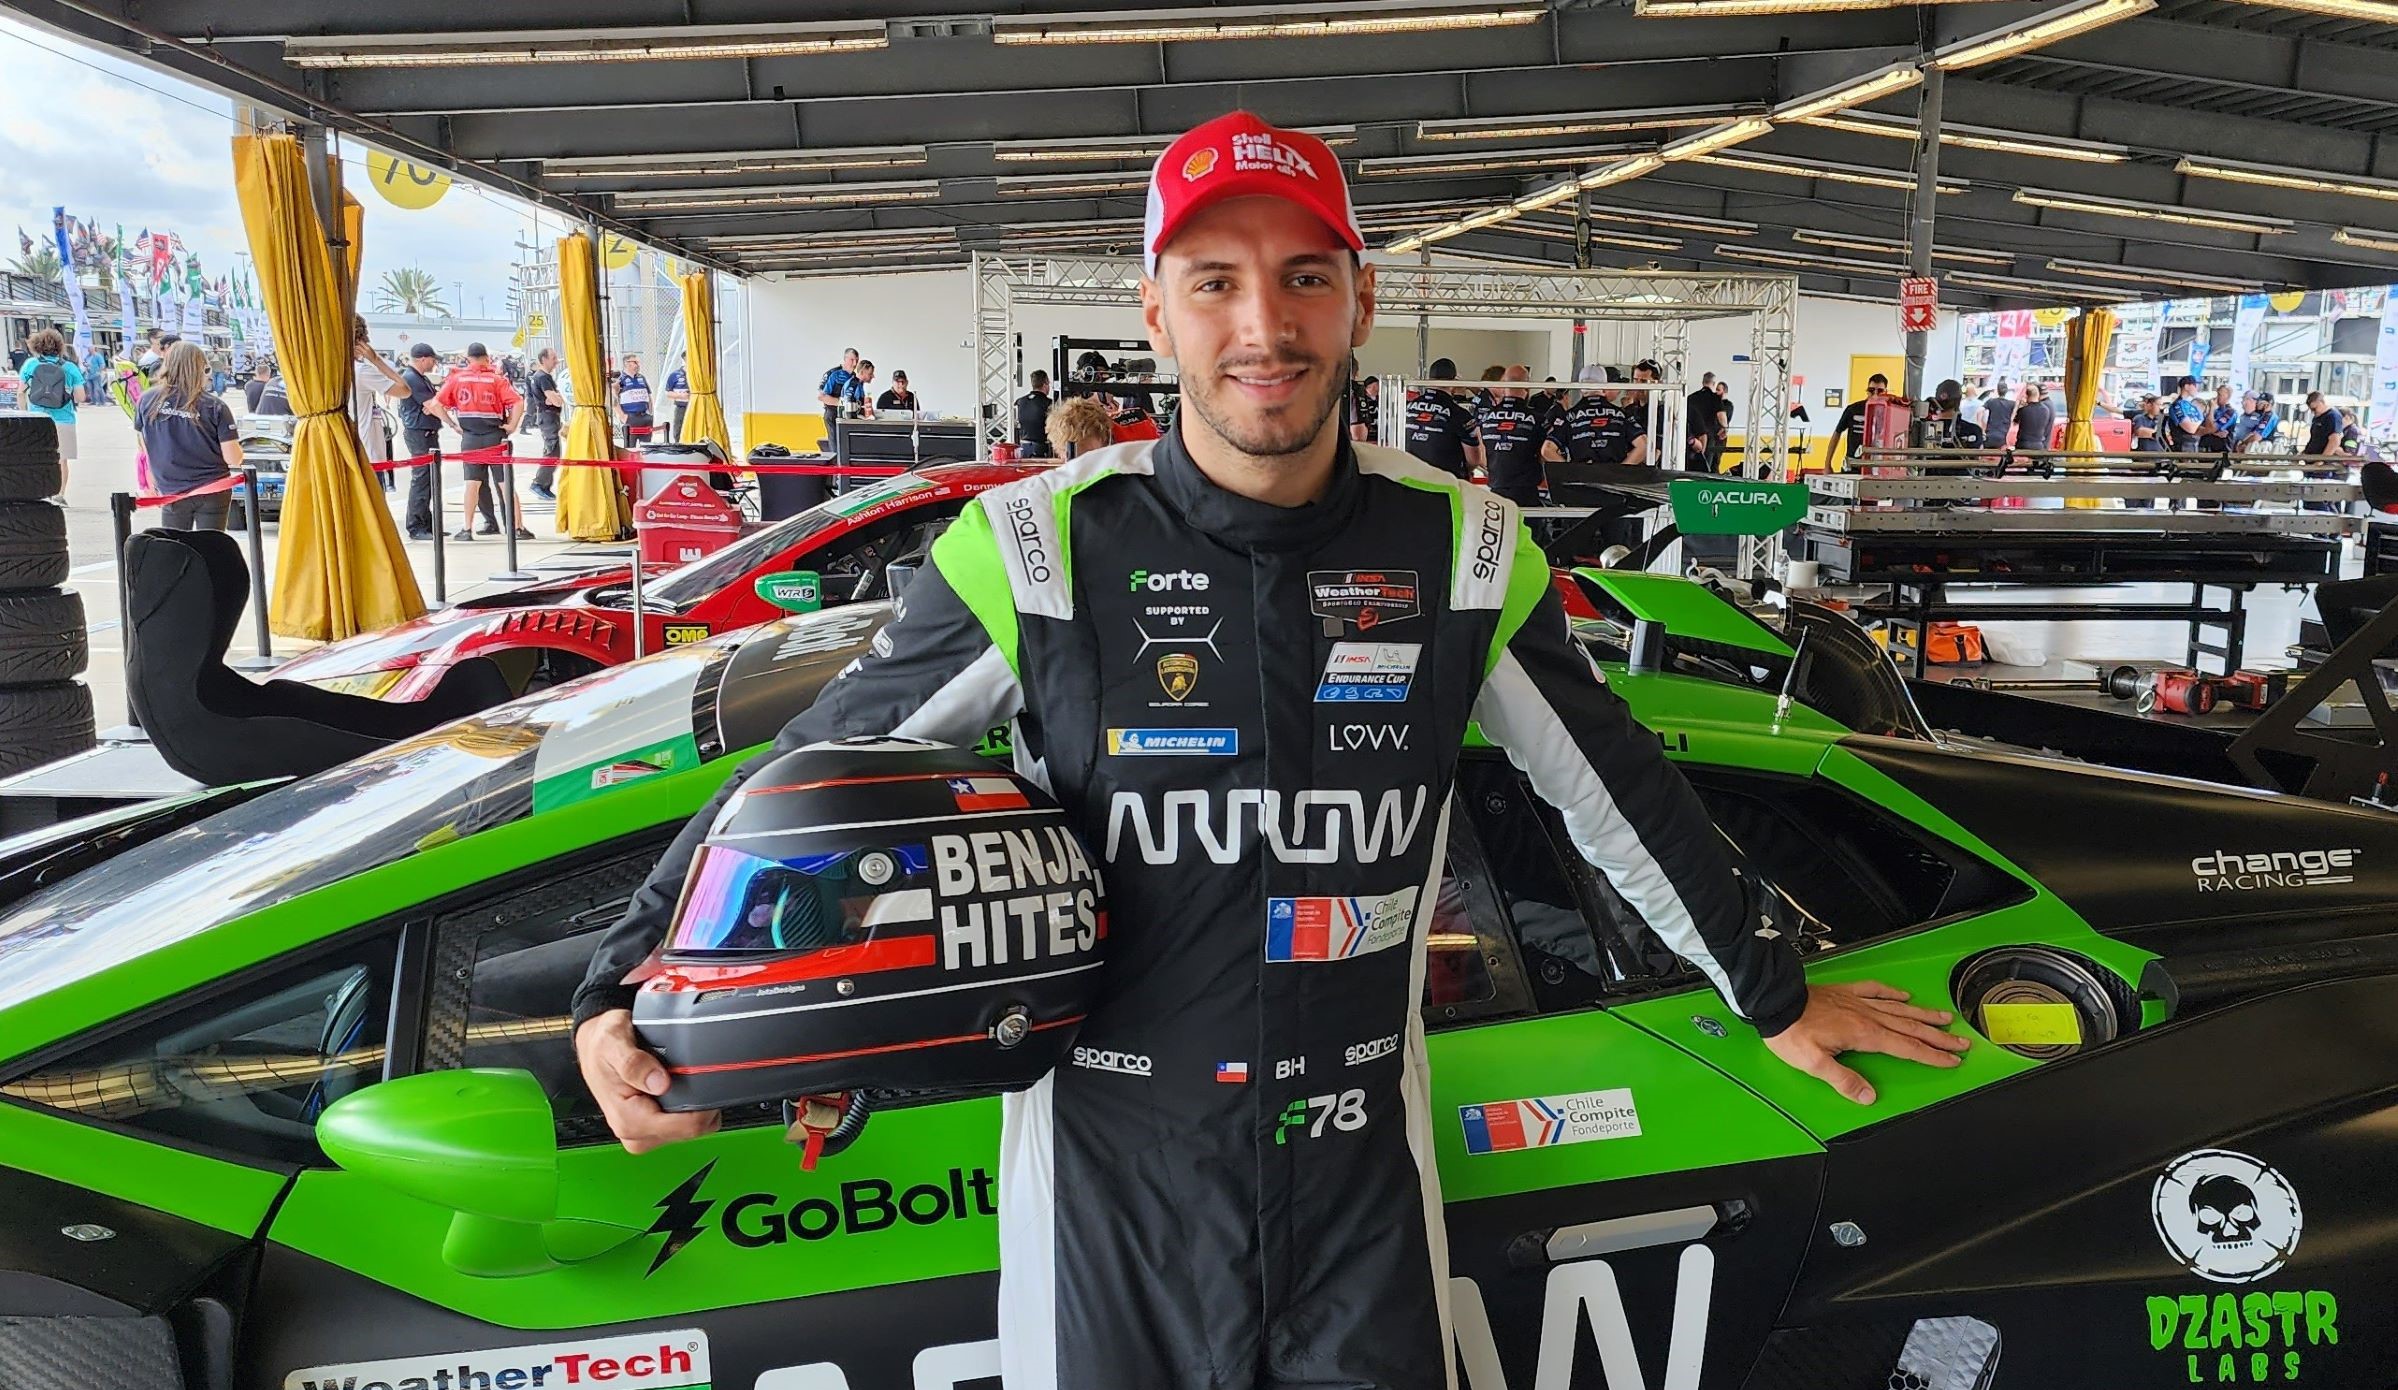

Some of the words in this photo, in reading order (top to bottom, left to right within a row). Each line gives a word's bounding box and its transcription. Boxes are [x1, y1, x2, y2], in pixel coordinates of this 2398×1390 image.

[1231, 132, 1272, 146] Shell
[1232, 142, 1319, 181] HELIX
[1909, 283, 1929, 295] FIRE
[528, 315, 544, 327] 25
[1410, 401, 1451, 417] ACURA
[1487, 410, 1536, 425] ACURA
[1575, 407, 1626, 420] ACURA
[1711, 491, 1783, 506] ACURA
[847, 506, 885, 527] Ashton
[886, 491, 933, 510] Harrison
[1012, 497, 1051, 584] sparco
[1472, 500, 1502, 583] sparco
[1129, 569, 1210, 592] Forte
[1314, 586, 1415, 599] WeatherTech
[1145, 606, 1210, 616] SUPPORTED
[1169, 616, 1186, 626] BY
[665, 628, 709, 643] OMP
[1143, 736, 1227, 748] MICHELIN
[1105, 785, 1427, 865] ARROW
[931, 826, 1095, 898] BENJA
[2197, 872, 2305, 893] RACING
[1374, 897, 1399, 916] Chile
[939, 888, 1098, 971] HITES
[1371, 908, 1412, 931] Compite
[1345, 1033, 1399, 1065] sparco
[1073, 1046, 1153, 1074] sparco
[1275, 1055, 1306, 1080] BH
[1566, 1096, 1604, 1112] Chile
[1569, 1107, 1636, 1125] Compite
[1572, 1120, 1636, 1137] Fondeporte
[720, 1167, 998, 1249] GoBolt
[2146, 1290, 2339, 1351] DZASTR
[2187, 1351, 2301, 1383] LABS
